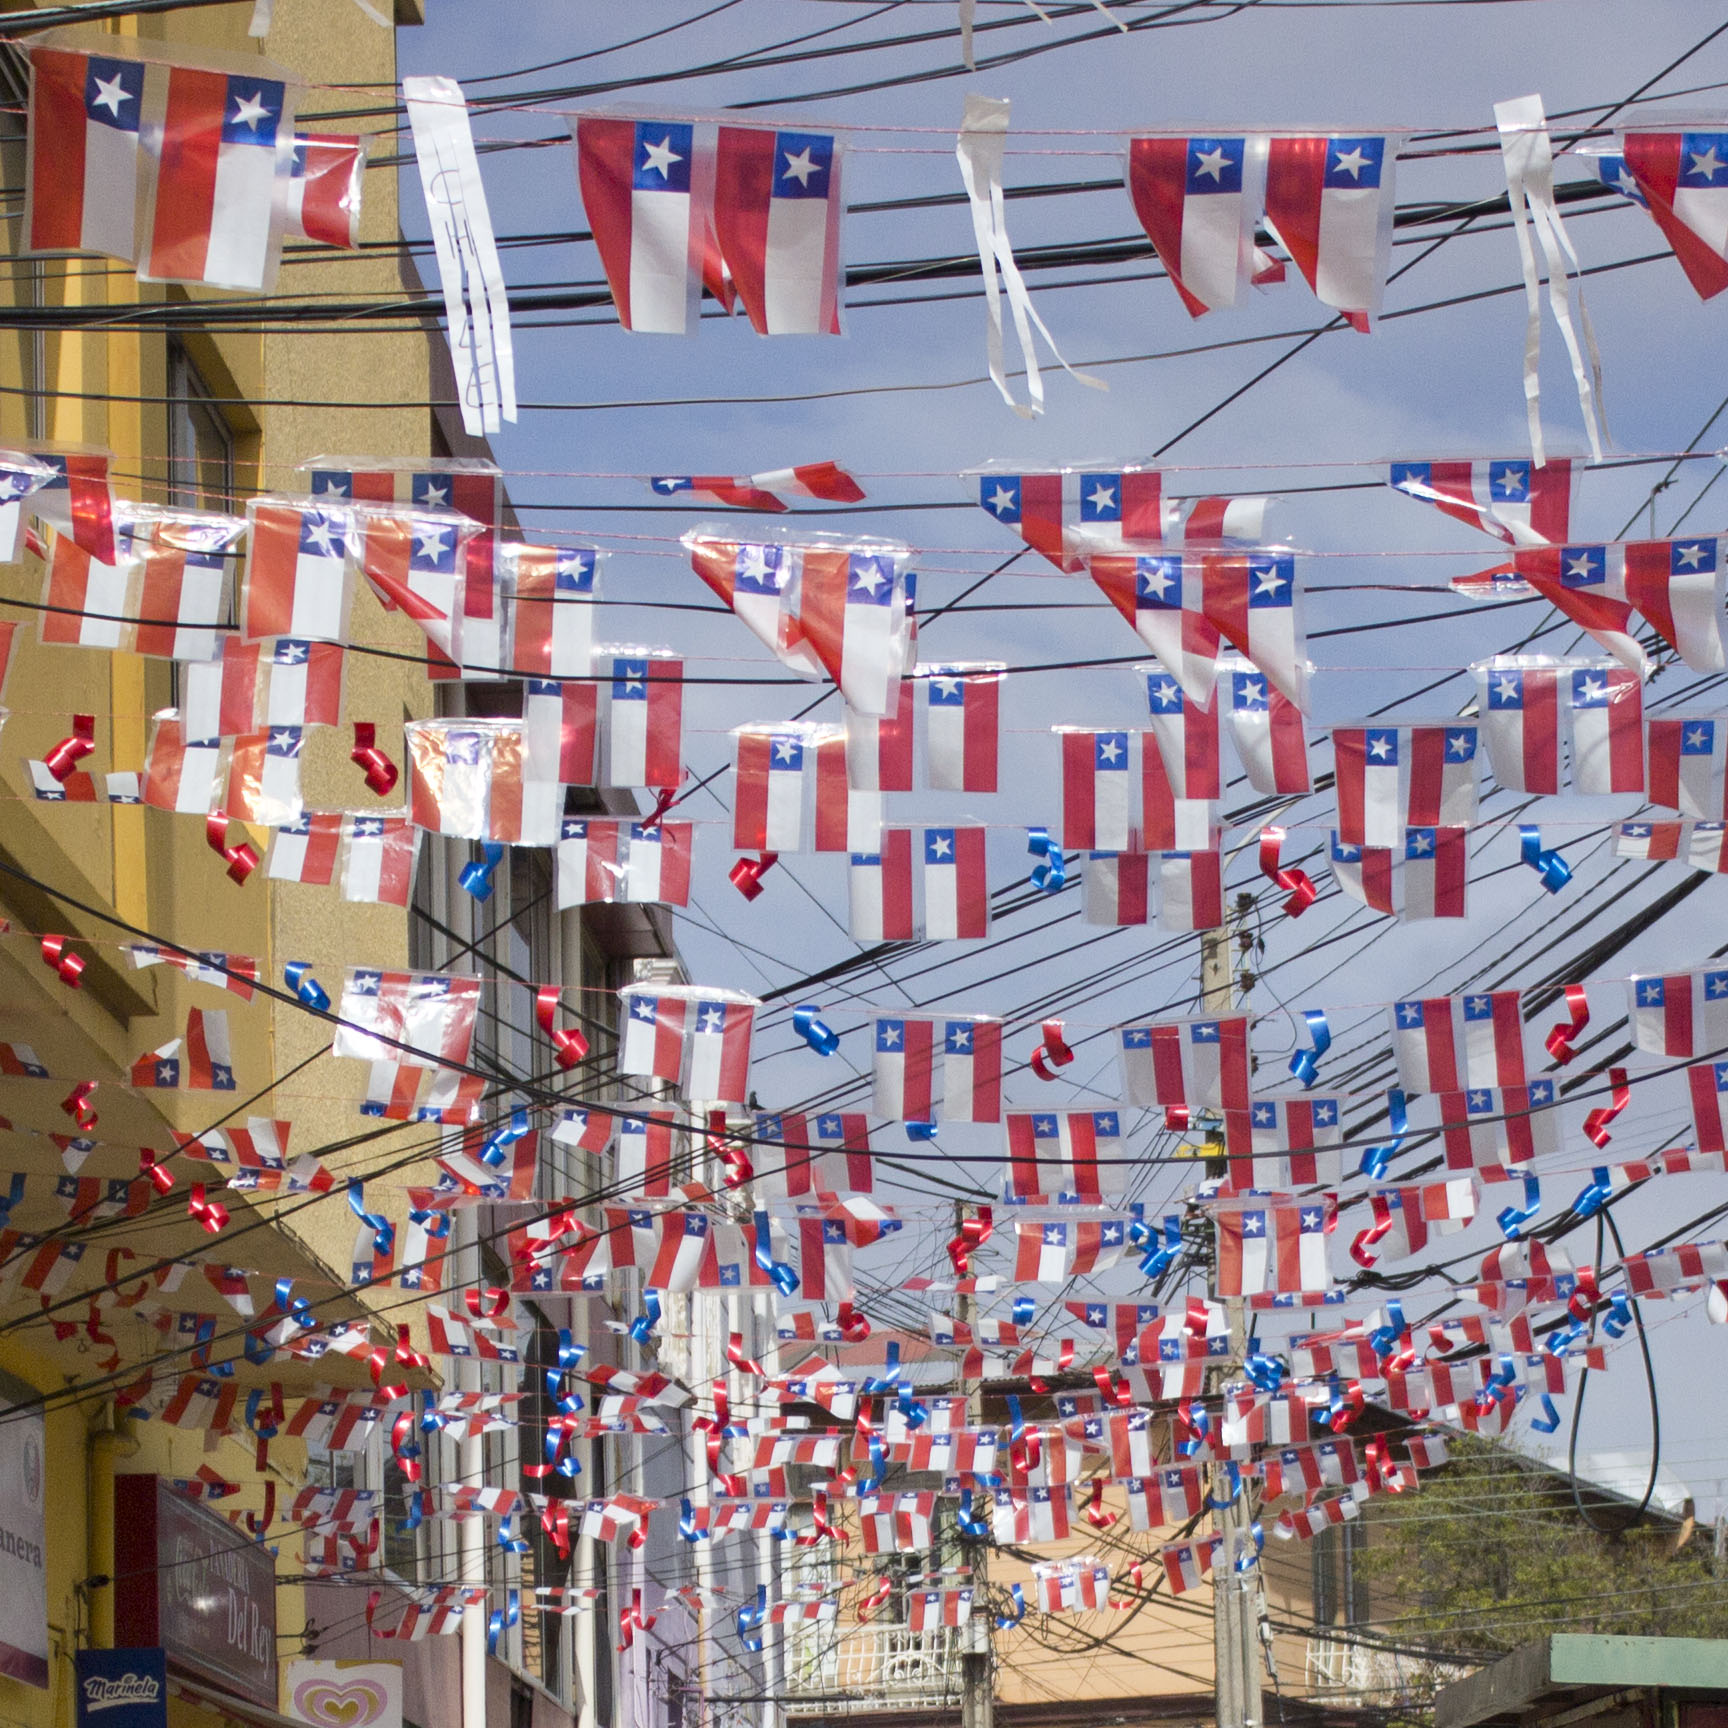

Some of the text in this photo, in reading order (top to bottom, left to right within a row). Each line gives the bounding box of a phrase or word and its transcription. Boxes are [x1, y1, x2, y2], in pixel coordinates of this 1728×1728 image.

[226, 1586, 272, 1681] Del Rey
[84, 1673, 159, 1701] Marinela
